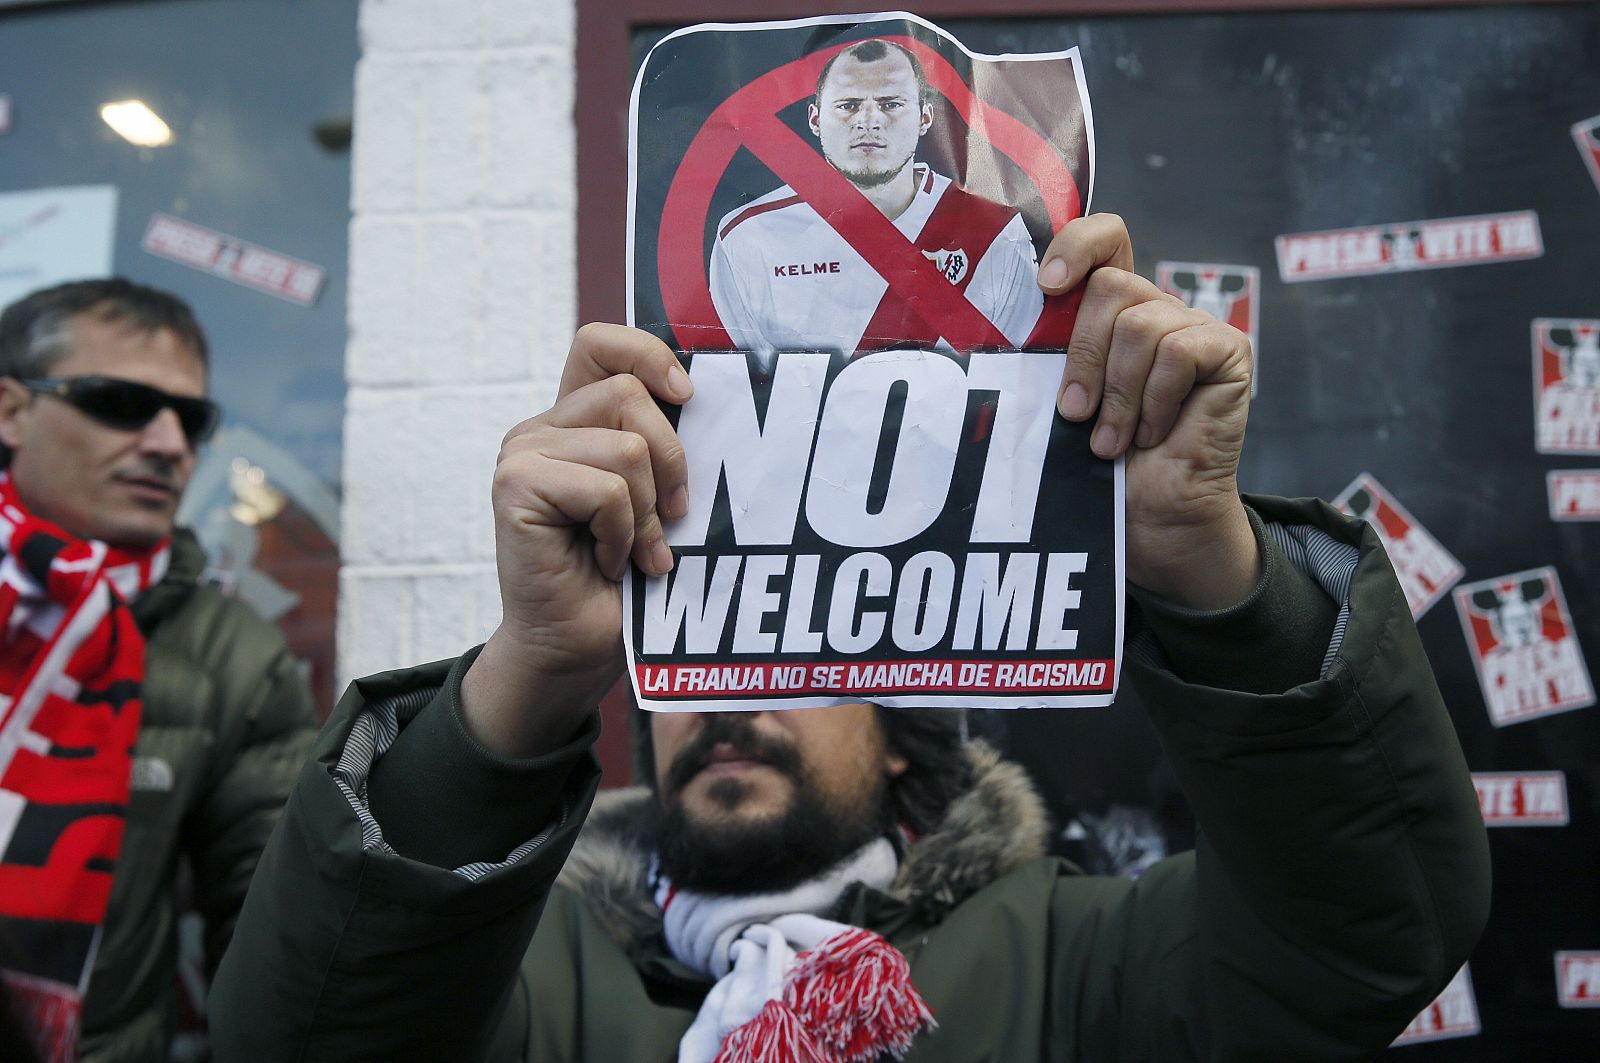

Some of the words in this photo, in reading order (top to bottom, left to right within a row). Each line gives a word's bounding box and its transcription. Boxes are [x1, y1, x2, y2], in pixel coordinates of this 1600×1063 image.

[774, 261, 841, 277] KELME
[667, 350, 1066, 547] NOT
[642, 551, 1088, 655] WELCOME
[644, 667, 669, 692] LA
[673, 667, 765, 691] FRANJA
[770, 666, 807, 690] NO
[810, 665, 844, 689] SE
[846, 663, 953, 689] MANCHA
[957, 663, 993, 687] DE
[994, 662, 1106, 687] RACISMO
